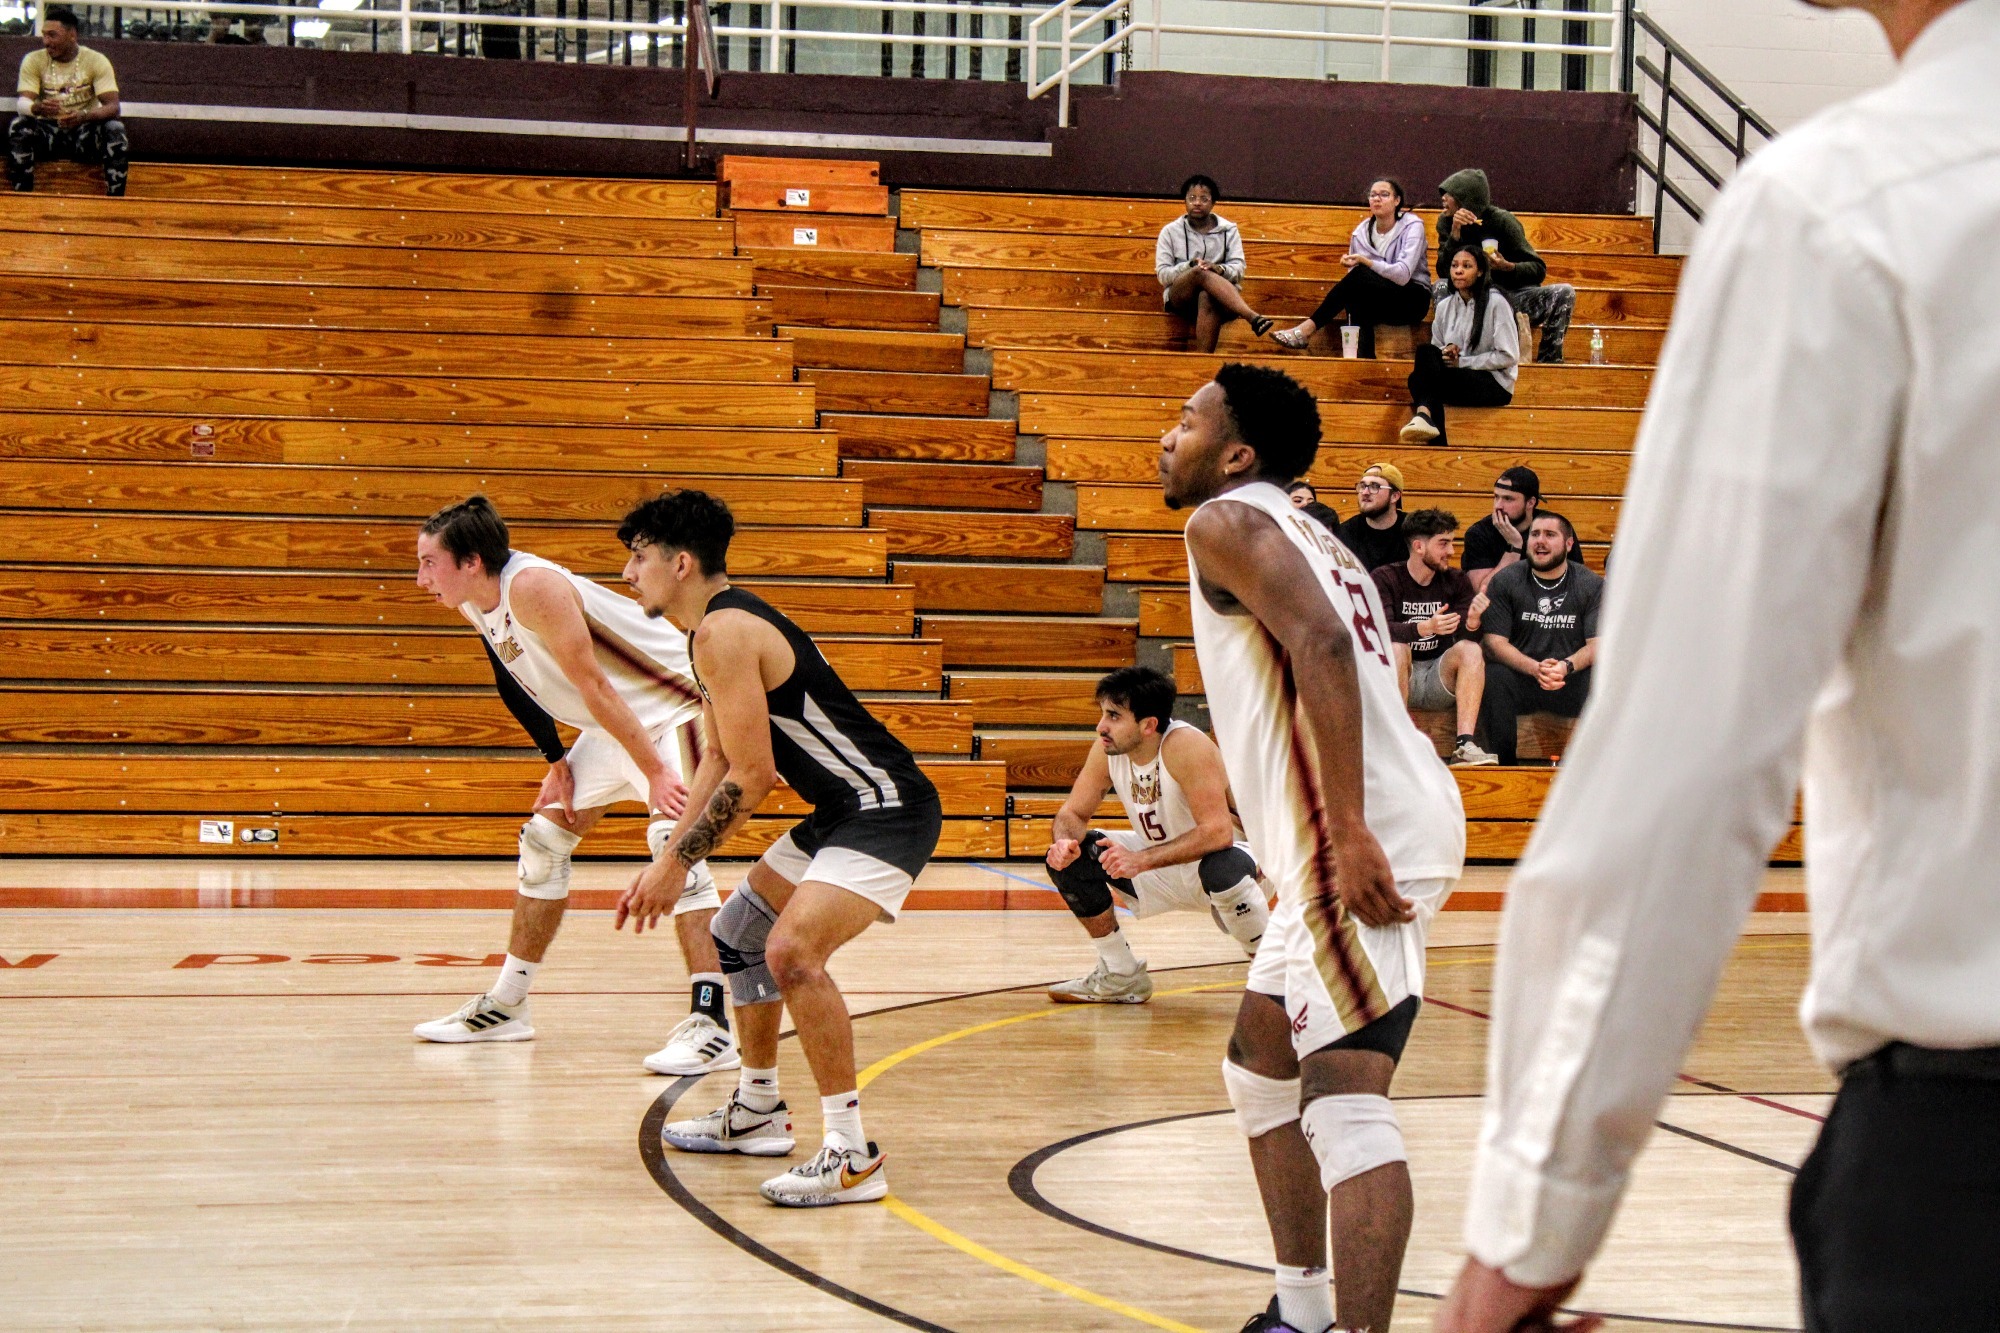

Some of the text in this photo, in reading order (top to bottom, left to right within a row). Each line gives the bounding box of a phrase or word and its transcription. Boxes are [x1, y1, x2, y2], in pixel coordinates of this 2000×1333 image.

[1521, 611, 1577, 624] ERSKINE
[1138, 809, 1167, 842] 15
[171, 952, 508, 970] Red
